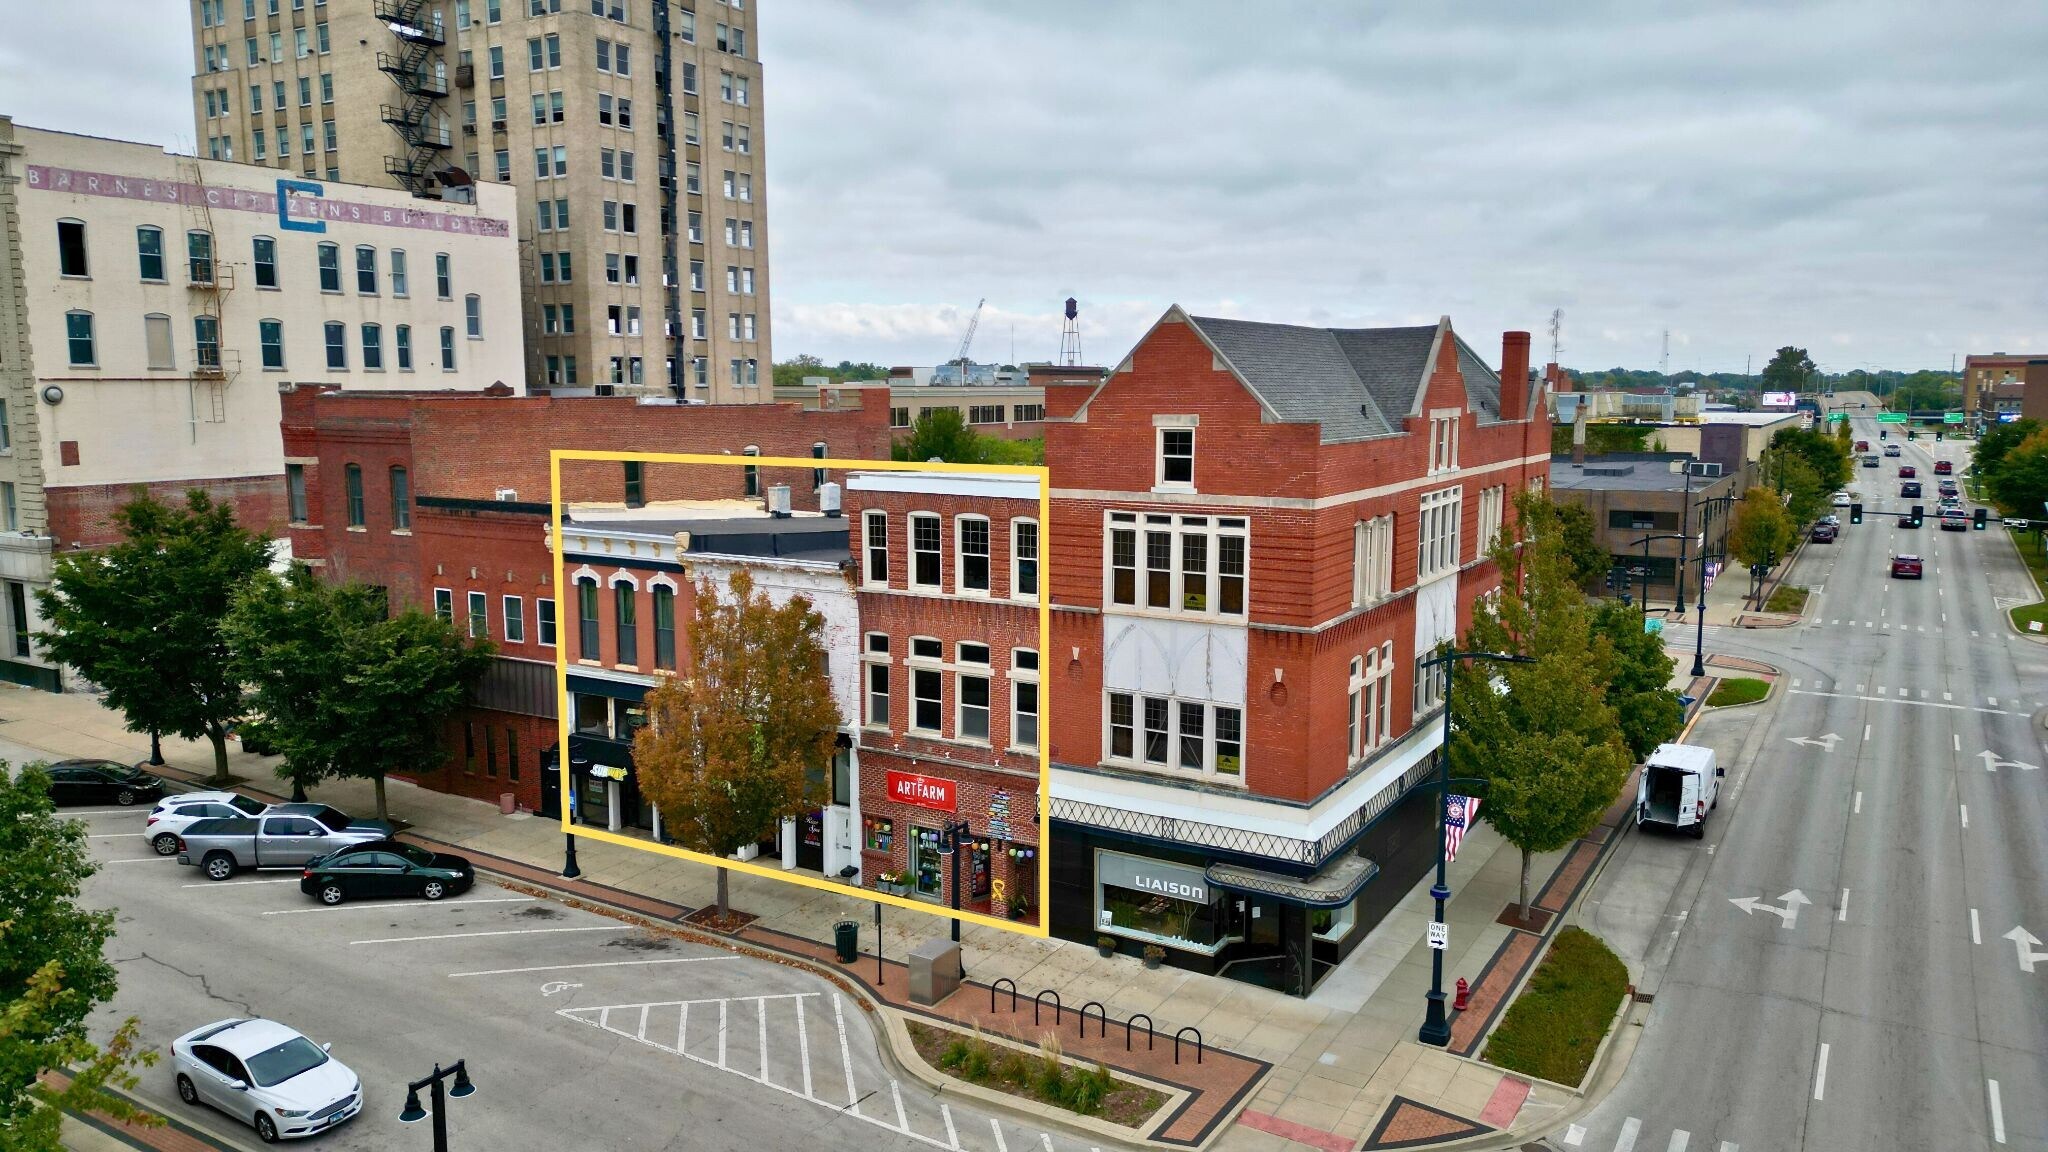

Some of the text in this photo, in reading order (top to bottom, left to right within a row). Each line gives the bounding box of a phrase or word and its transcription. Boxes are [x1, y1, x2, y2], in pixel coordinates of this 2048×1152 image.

[29, 169, 506, 235] BARNES CITIZENS BULDI
[590, 763, 628, 781] SUBWAY
[1135, 875, 1203, 899] LIAISON
[1430, 924, 1446, 933] ONE
